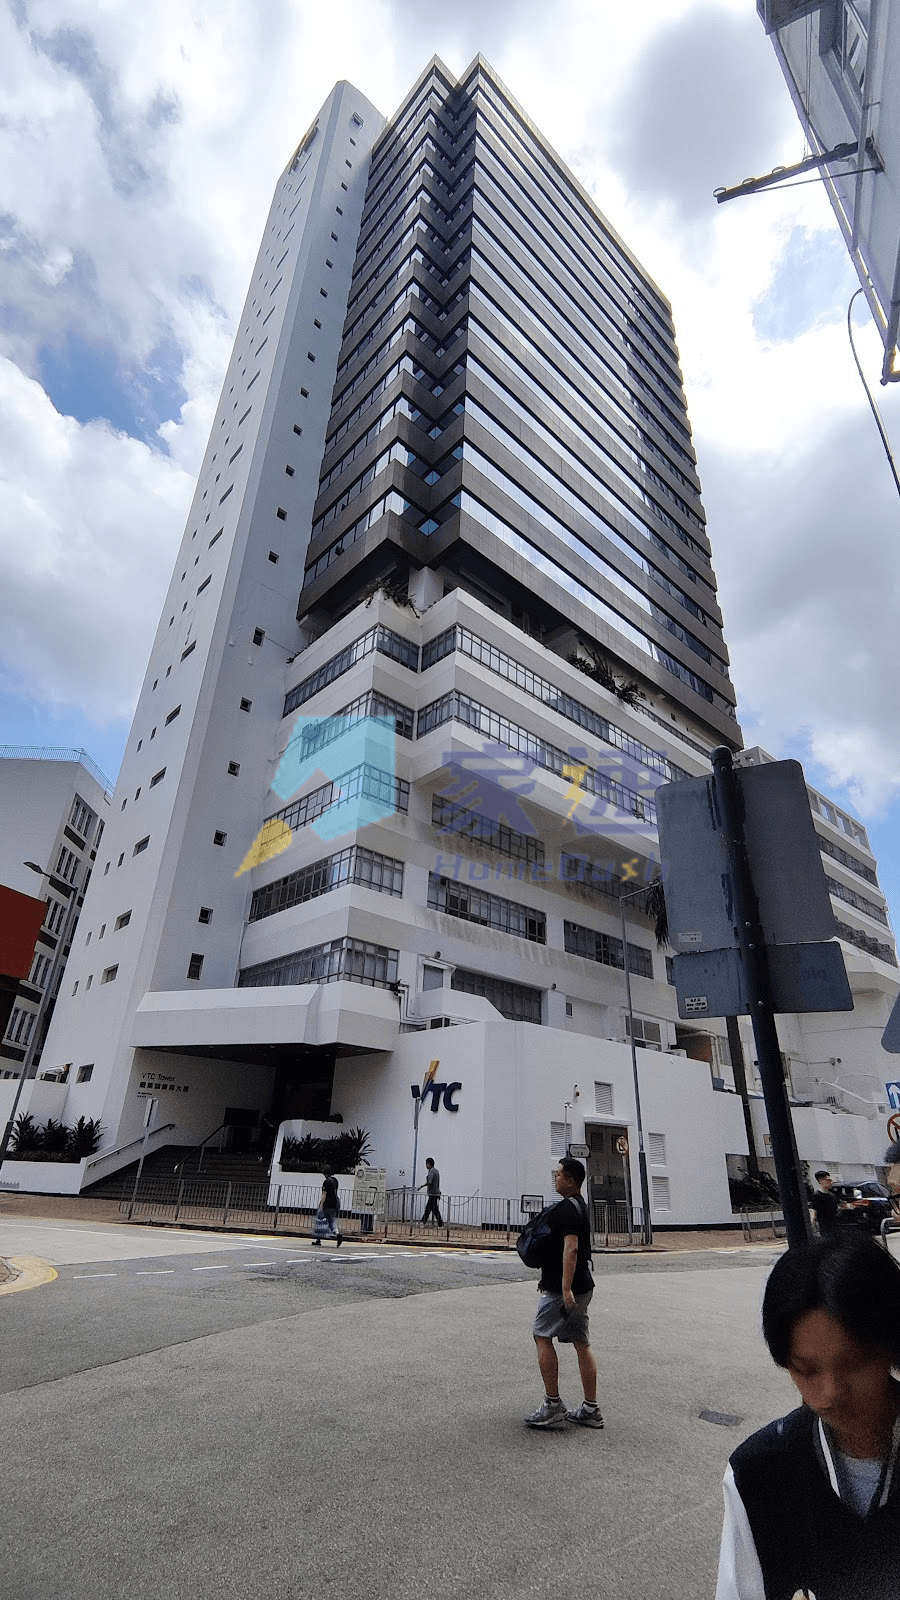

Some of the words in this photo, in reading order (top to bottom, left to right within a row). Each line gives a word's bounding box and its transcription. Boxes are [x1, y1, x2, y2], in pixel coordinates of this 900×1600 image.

[141, 1072, 156, 1080] VTC
[158, 1073, 176, 1082] Tower
[411, 1067, 462, 1112] VTC
